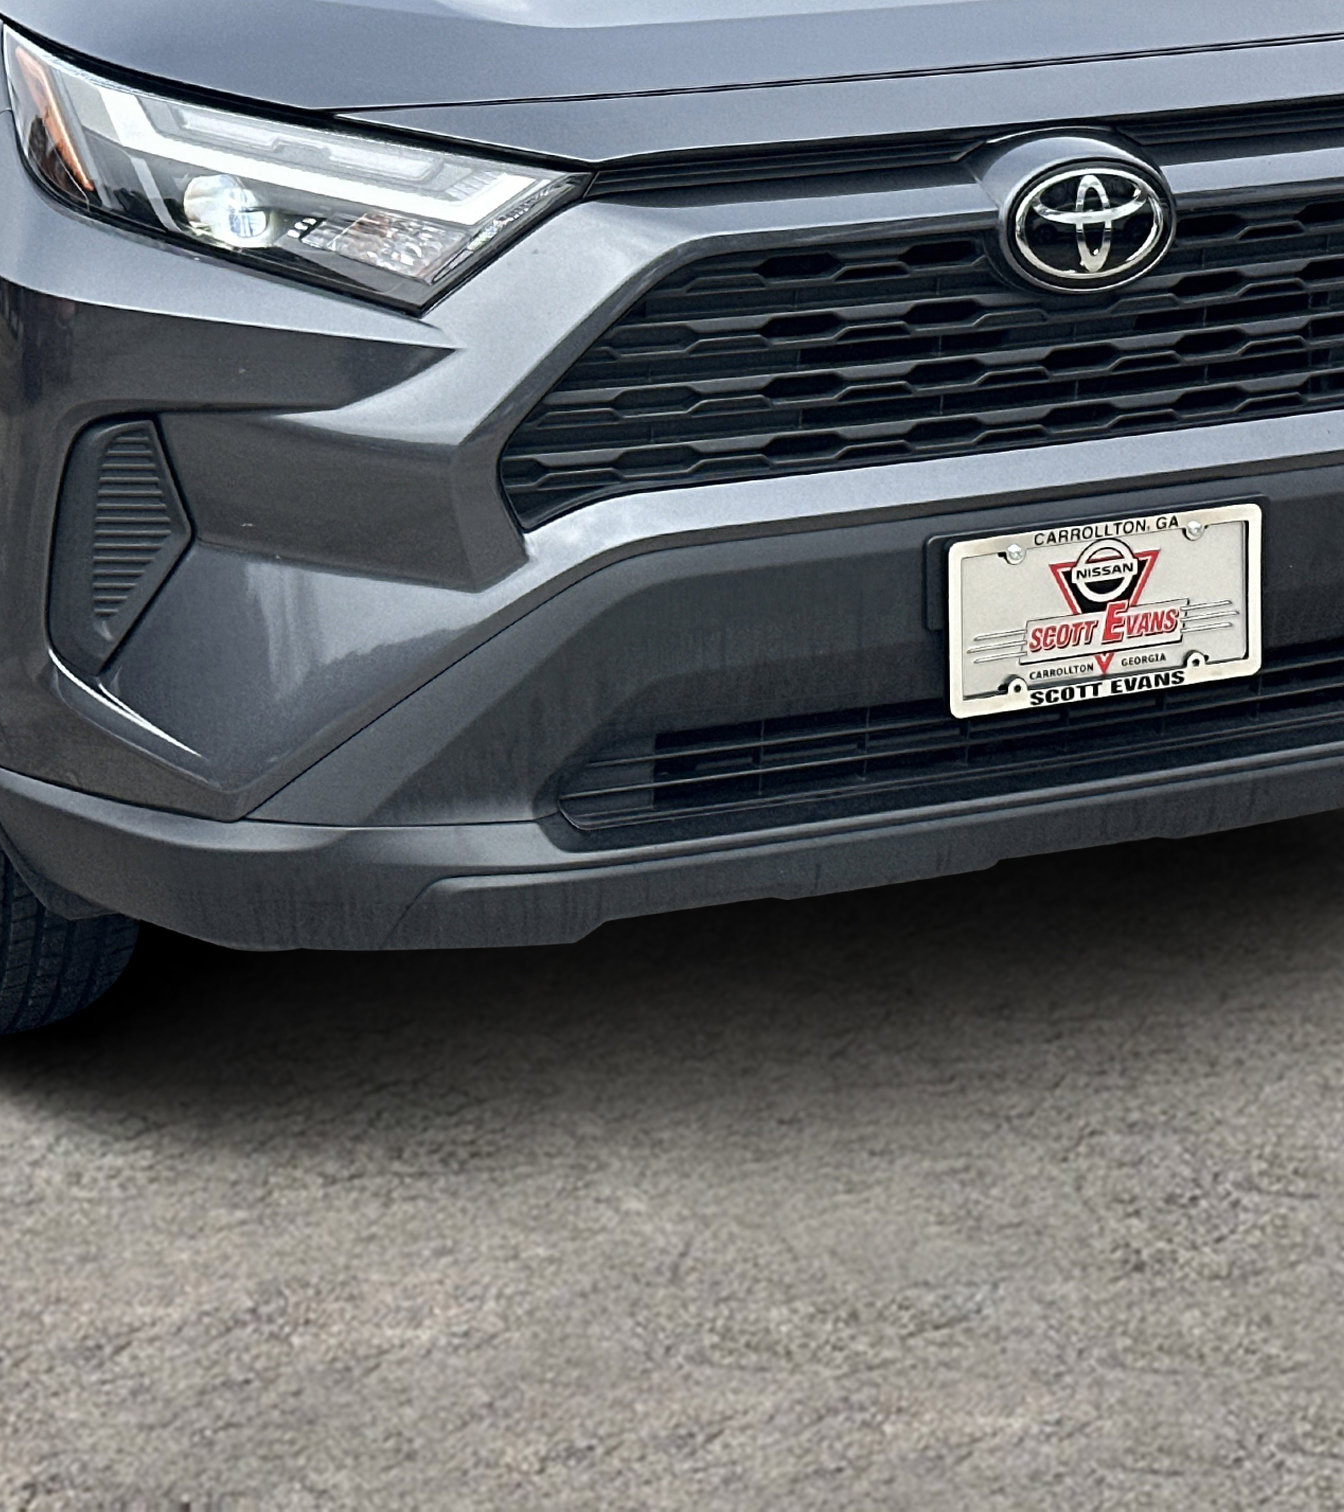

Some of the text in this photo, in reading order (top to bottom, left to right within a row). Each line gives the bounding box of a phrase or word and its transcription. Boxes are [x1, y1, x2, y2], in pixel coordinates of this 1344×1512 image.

[1034, 515, 1179, 546] CARROLLTON, GA
[1076, 562, 1134, 579] NISSAN
[1029, 620, 1098, 652] SCOTT
[1029, 653, 1167, 680] CARROLLTON GEORGIA
[1030, 670, 1185, 706] SCOTT EVANS
